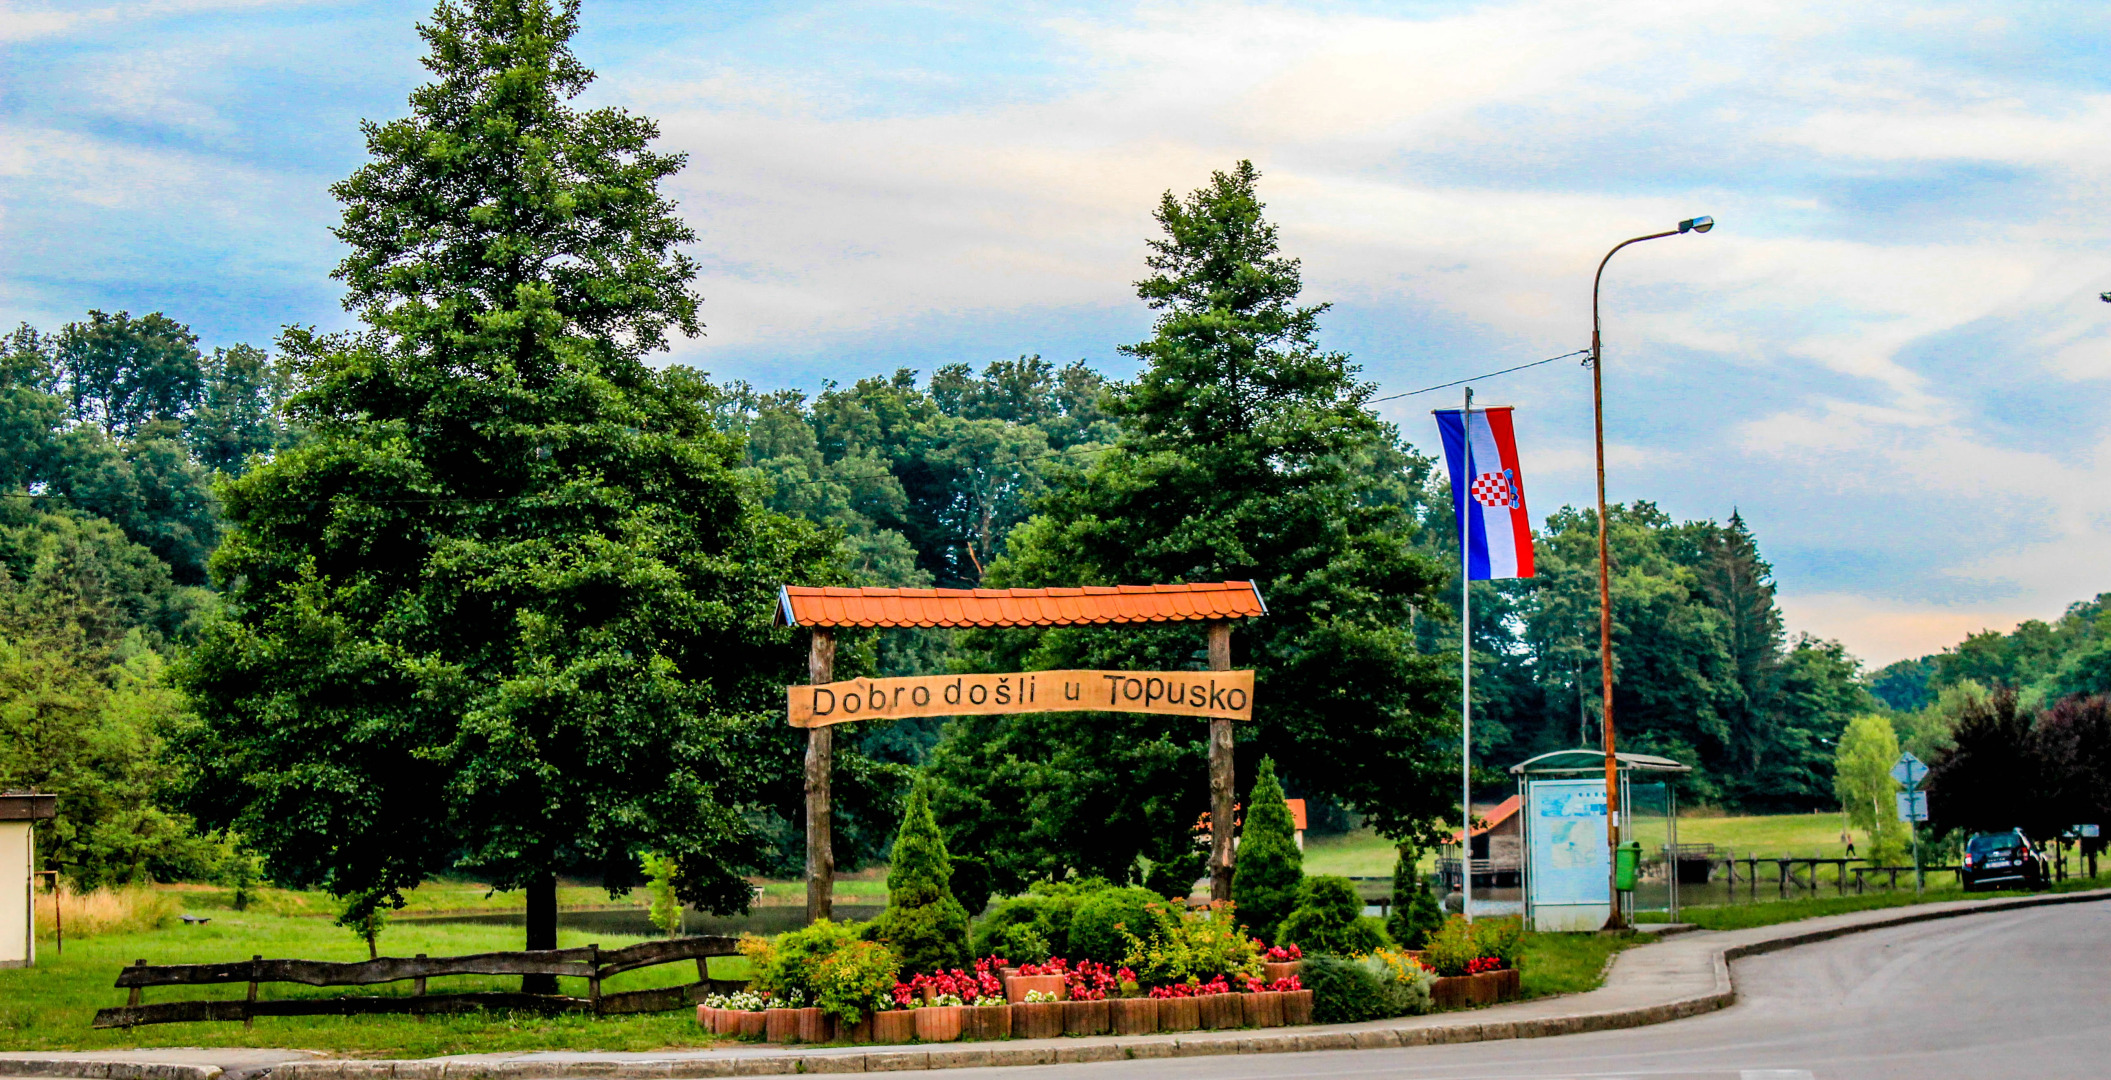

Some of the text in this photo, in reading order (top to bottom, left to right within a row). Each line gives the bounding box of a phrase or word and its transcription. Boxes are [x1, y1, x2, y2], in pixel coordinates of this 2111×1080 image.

[813, 674, 1247, 716] Dobro došli u Topusko
